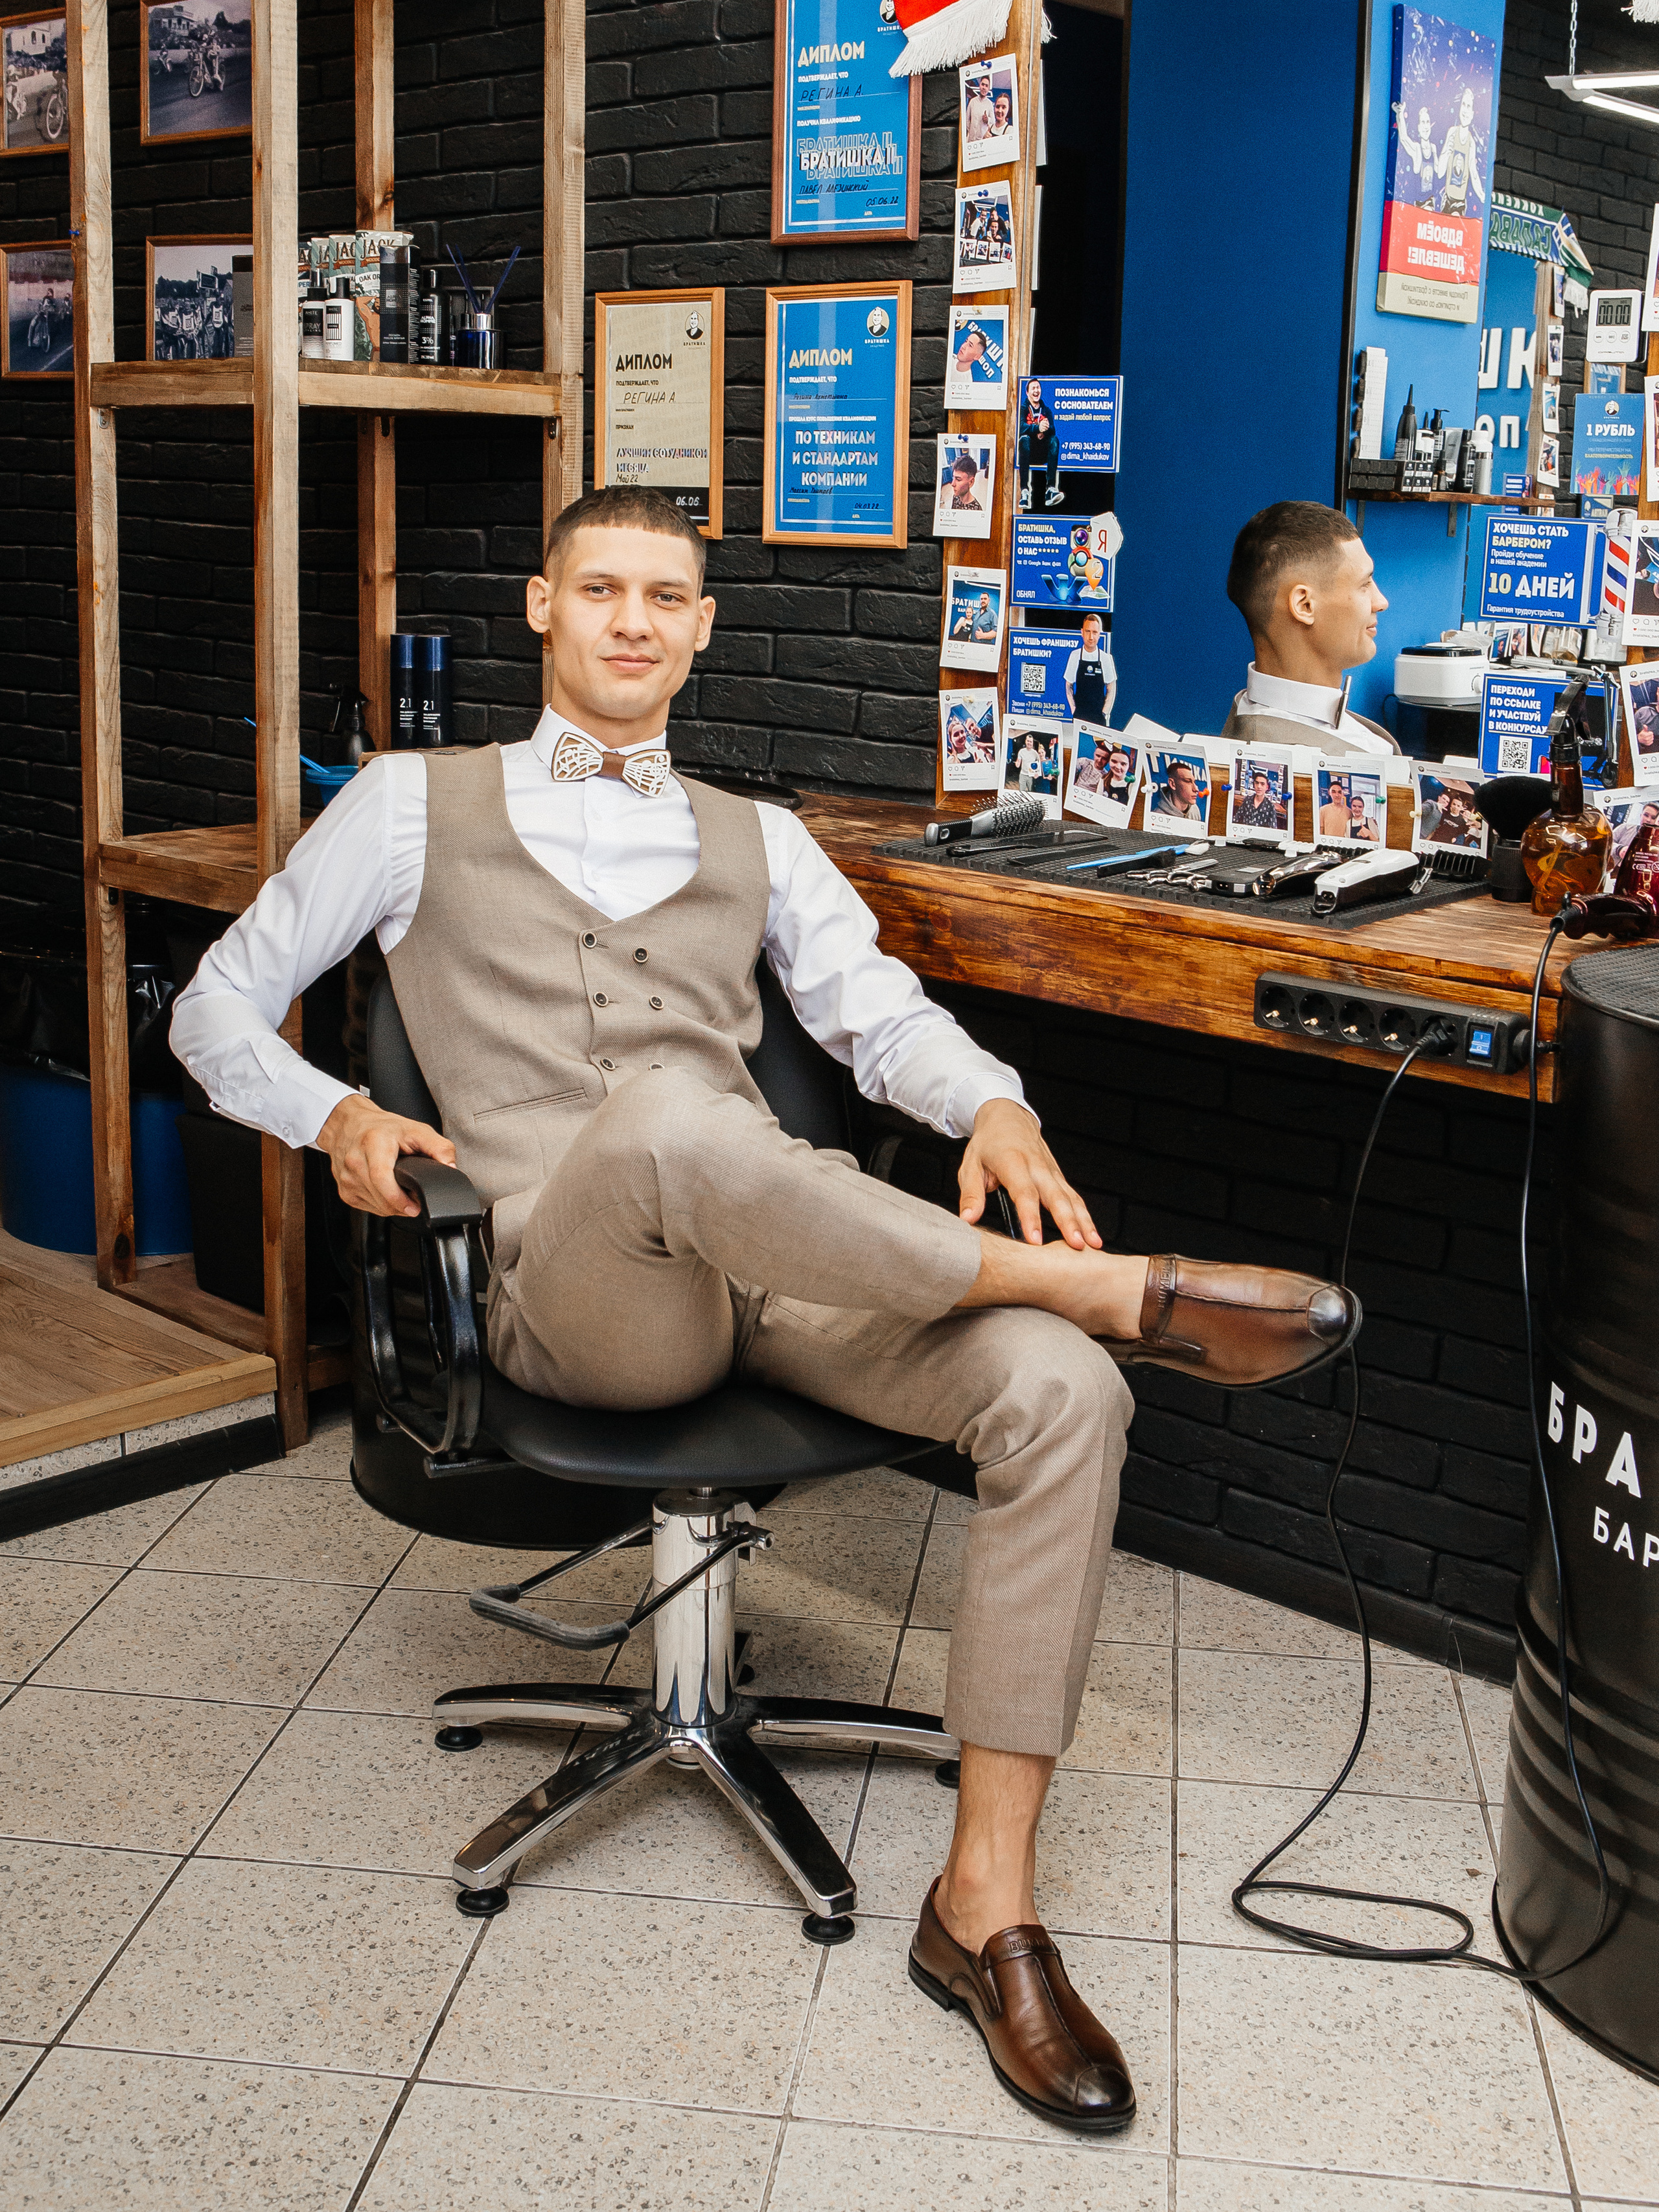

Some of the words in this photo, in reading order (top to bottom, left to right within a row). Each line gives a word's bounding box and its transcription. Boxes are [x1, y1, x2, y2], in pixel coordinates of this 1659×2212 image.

[798, 41, 865, 67] ДИПЛОМ
[798, 73, 838, 82] ПОДТВЕРЖДАЕТ,
[800, 87, 850, 101] РЕГИНА
[854, 84, 863, 97] А.
[800, 145, 883, 170] БРАТИШКА
[800, 185, 822, 194] ПАВЕЛ
[333, 242, 356, 262] JAC
[616, 353, 672, 372] ДИПЛОМ
[789, 348, 852, 369] ДИПЛОМ
[623, 391, 666, 404] РЕГИНА
[669, 391, 676, 403] А.
[1055, 388, 1109, 397] ПОЗНАКОМЬСЯ
[1054, 401, 1061, 410] С
[1061, 401, 1113, 410] ОСНОВАТЕЛЕМ
[1586, 425, 1593, 436] 1
[1595, 424, 1636, 437] РУБЛЬ
[795, 430, 812, 444] ПО
[813, 430, 876, 445] ТЕХНИКАМ
[1069, 442, 1082, 450] (995)
[792, 451, 800, 465] И
[802, 451, 878, 466] СТАНДАРТАМ
[616, 463, 649, 473] МЕСЯЦА
[616, 474, 629, 483] Май
[801, 472, 868, 486] КОМПАНИИ
[1018, 524, 1056, 533] БРАТИШКА,
[1493, 522, 1537, 535] ХОЧЕШЬ
[1537, 526, 1570, 537] СТАТЬ
[1018, 536, 1044, 544] ОСТАВЬ
[1097, 529, 1107, 553] Я
[1492, 535, 1551, 550] БАРБЕРОМ?
[1491, 549, 1514, 558] Пройди
[1515, 550, 1544, 560] обучение
[1495, 557, 1516, 566] нашей
[1488, 572, 1512, 594] 10
[1514, 572, 1575, 600] ДНЕЙ
[1016, 590, 1036, 599] ОБНЯЛ
[1487, 604, 1514, 613] Гарантия
[1514, 607, 1564, 618] трудоустройства
[1013, 636, 1041, 646] ХОЧЕШЬ
[1041, 638, 1079, 647] ФРАНШИЗУ
[1013, 648, 1052, 658] БРАТИШКИ?
[1491, 684, 1535, 697] ПЕРЕХОДИ
[400, 698, 411, 708] 2.1
[423, 700, 434, 710] 2.1
[1491, 697, 1503, 706] ПО
[1504, 697, 1541, 710] ССЫЛКЕ
[1497, 710, 1540, 722] УЧАСТВУЙ
[1489, 721, 1494, 729] В
[1496, 721, 1548, 734] КОНКУРСАХ
[1548, 1381, 1641, 1498] БРА
